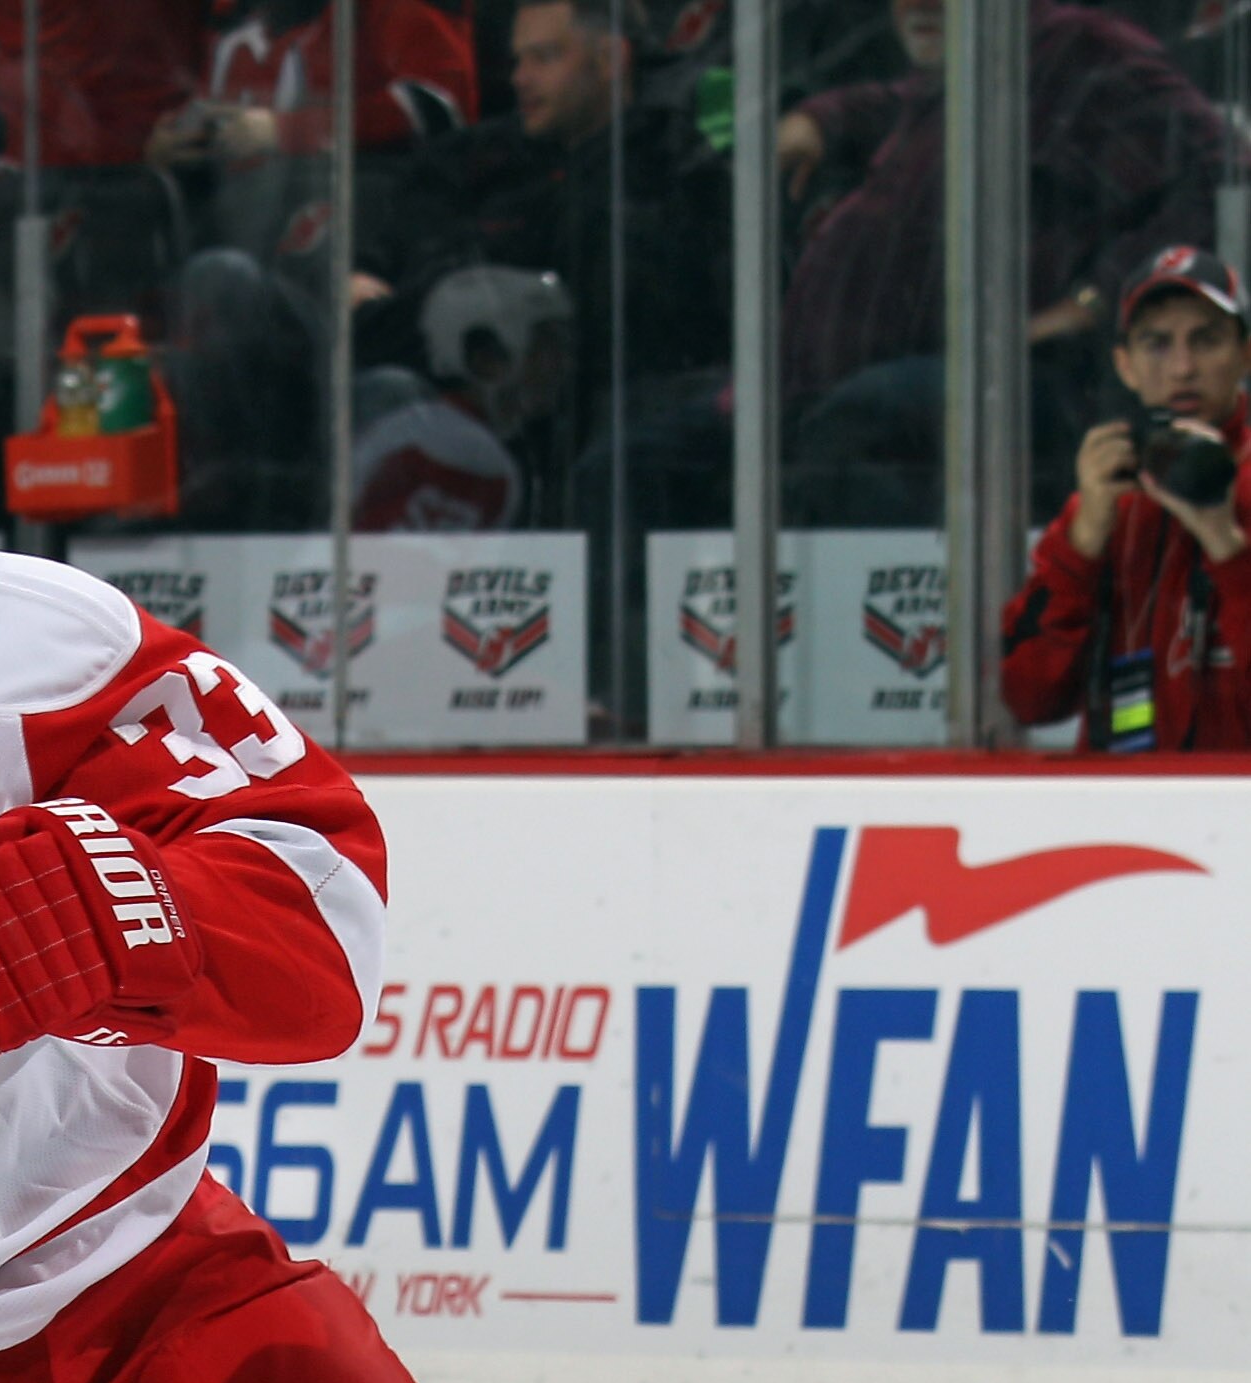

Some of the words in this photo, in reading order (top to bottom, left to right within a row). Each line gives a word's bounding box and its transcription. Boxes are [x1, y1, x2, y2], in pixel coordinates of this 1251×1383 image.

[110, 651, 306, 800] 33
[149, 869, 186, 938] DRAPER
[413, 984, 611, 1060] RADIO
[636, 826, 1201, 1337] WFAN
[395, 1274, 492, 1317] YORK
